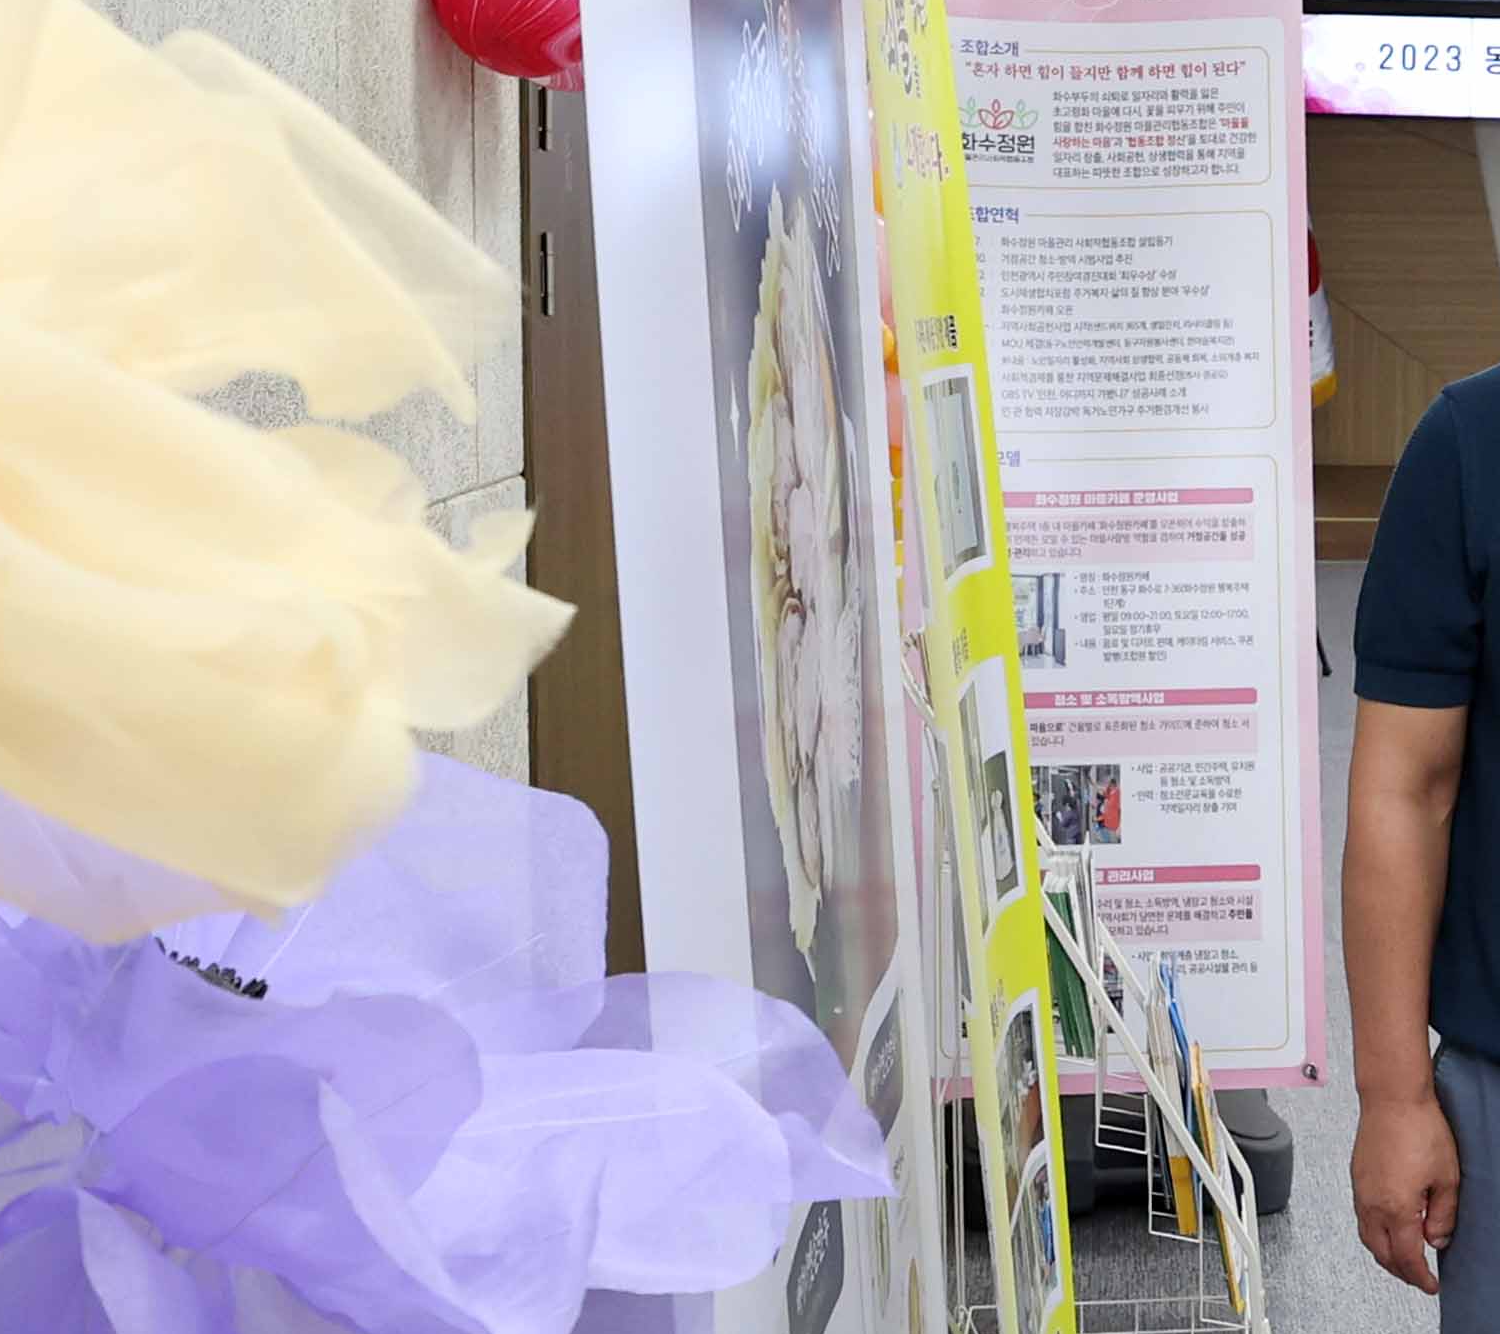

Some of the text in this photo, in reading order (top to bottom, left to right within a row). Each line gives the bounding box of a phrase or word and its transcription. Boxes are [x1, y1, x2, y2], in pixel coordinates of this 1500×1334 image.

[961, 40, 1020, 56] 조합소개
[1380, 44, 1462, 72] 2023
[1006, 63, 1031, 79] 하면
[1038, 63, 1064, 80] 힘이
[1117, 64, 1143, 80] 함께
[1148, 64, 1175, 79] 하면
[1182, 62, 1207, 78] 힘이
[1096, 122, 1132, 132] 화수정원
